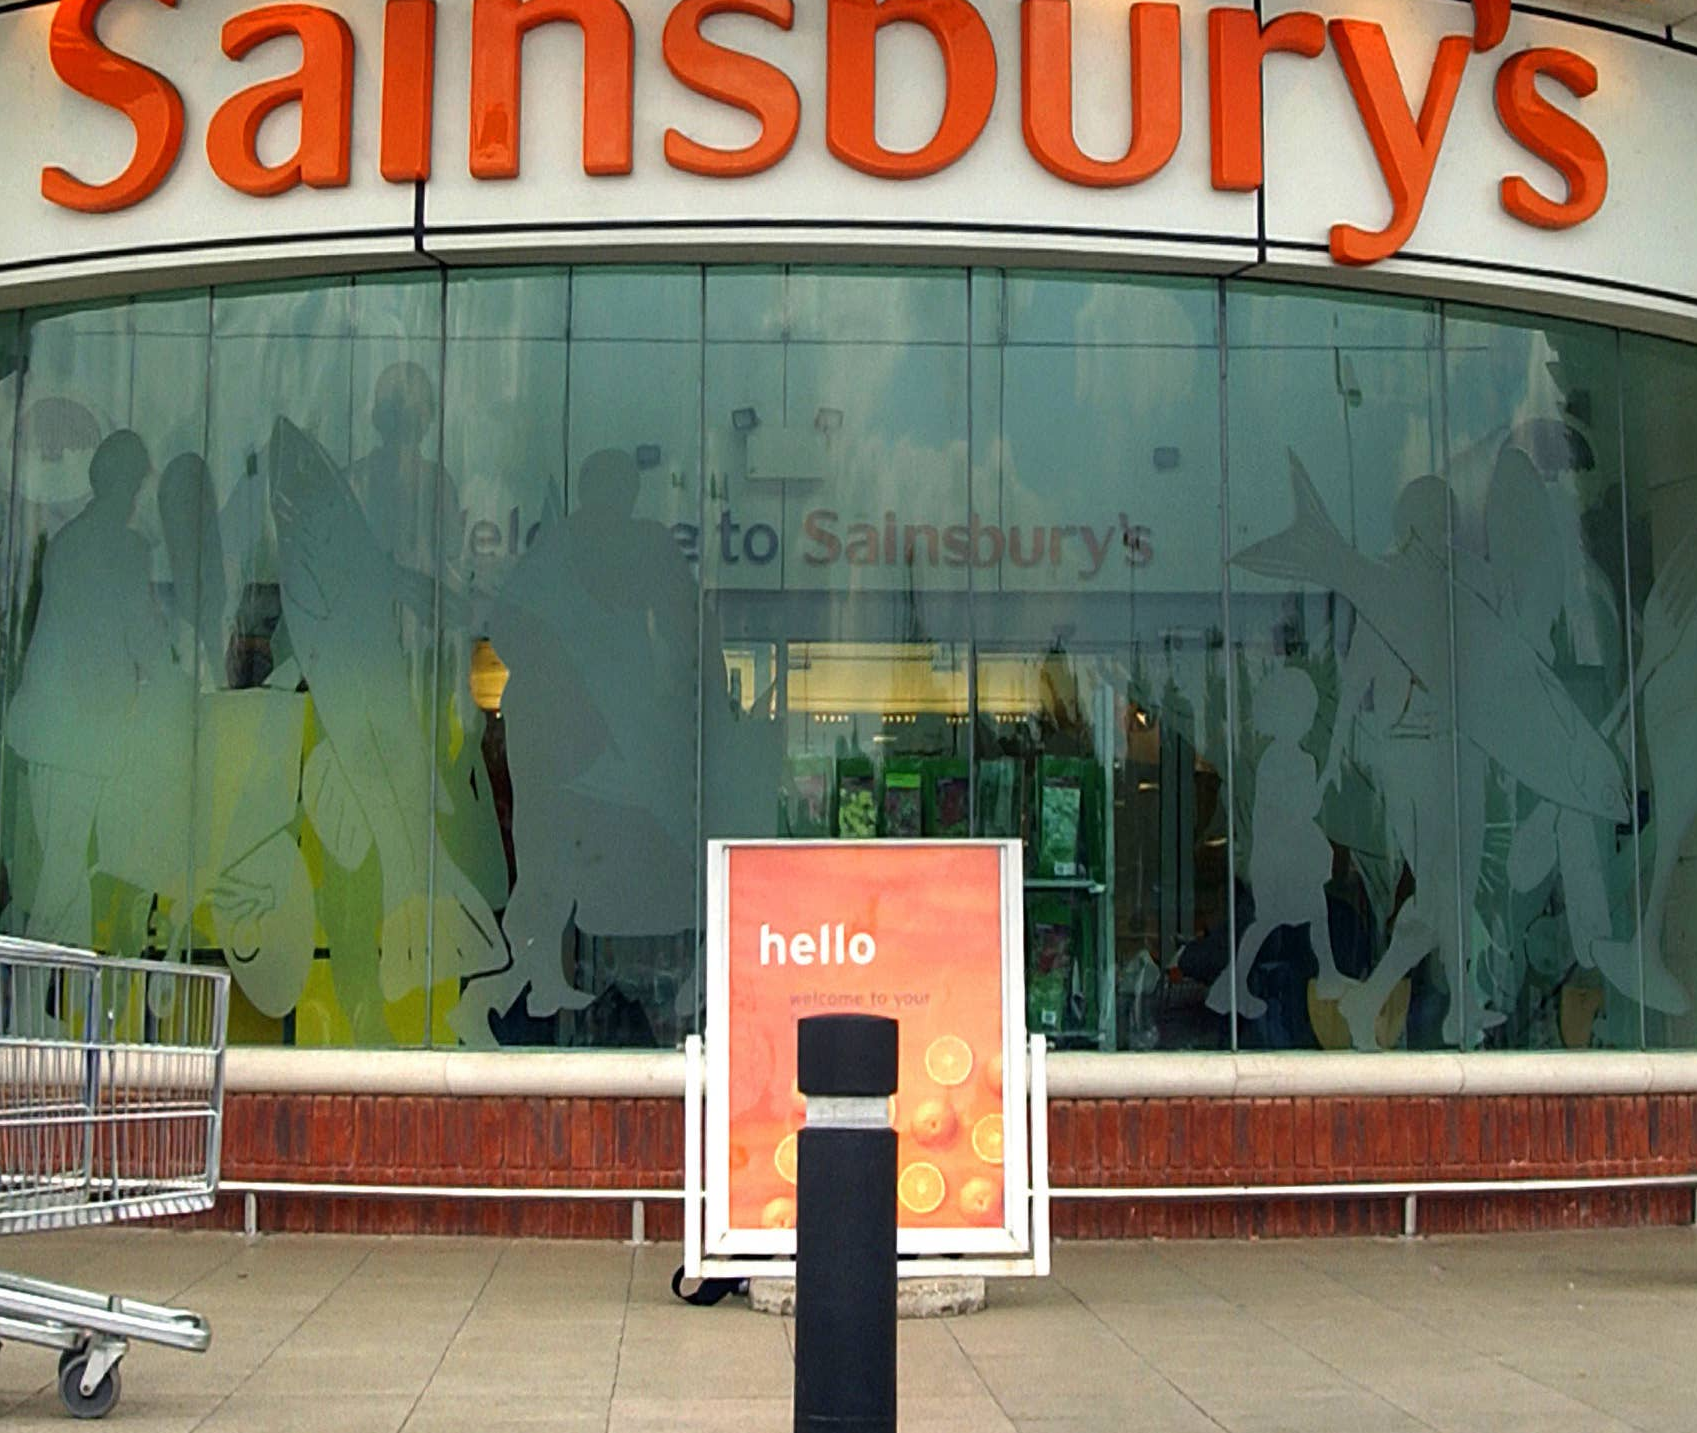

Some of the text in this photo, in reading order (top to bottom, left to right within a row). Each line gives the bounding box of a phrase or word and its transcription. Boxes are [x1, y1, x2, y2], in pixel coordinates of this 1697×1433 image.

[719, 509, 779, 566] to
[803, 508, 1153, 580] Sainsbury's
[760, 922, 876, 965] hello
[790, 991, 931, 1008] welcome to your
